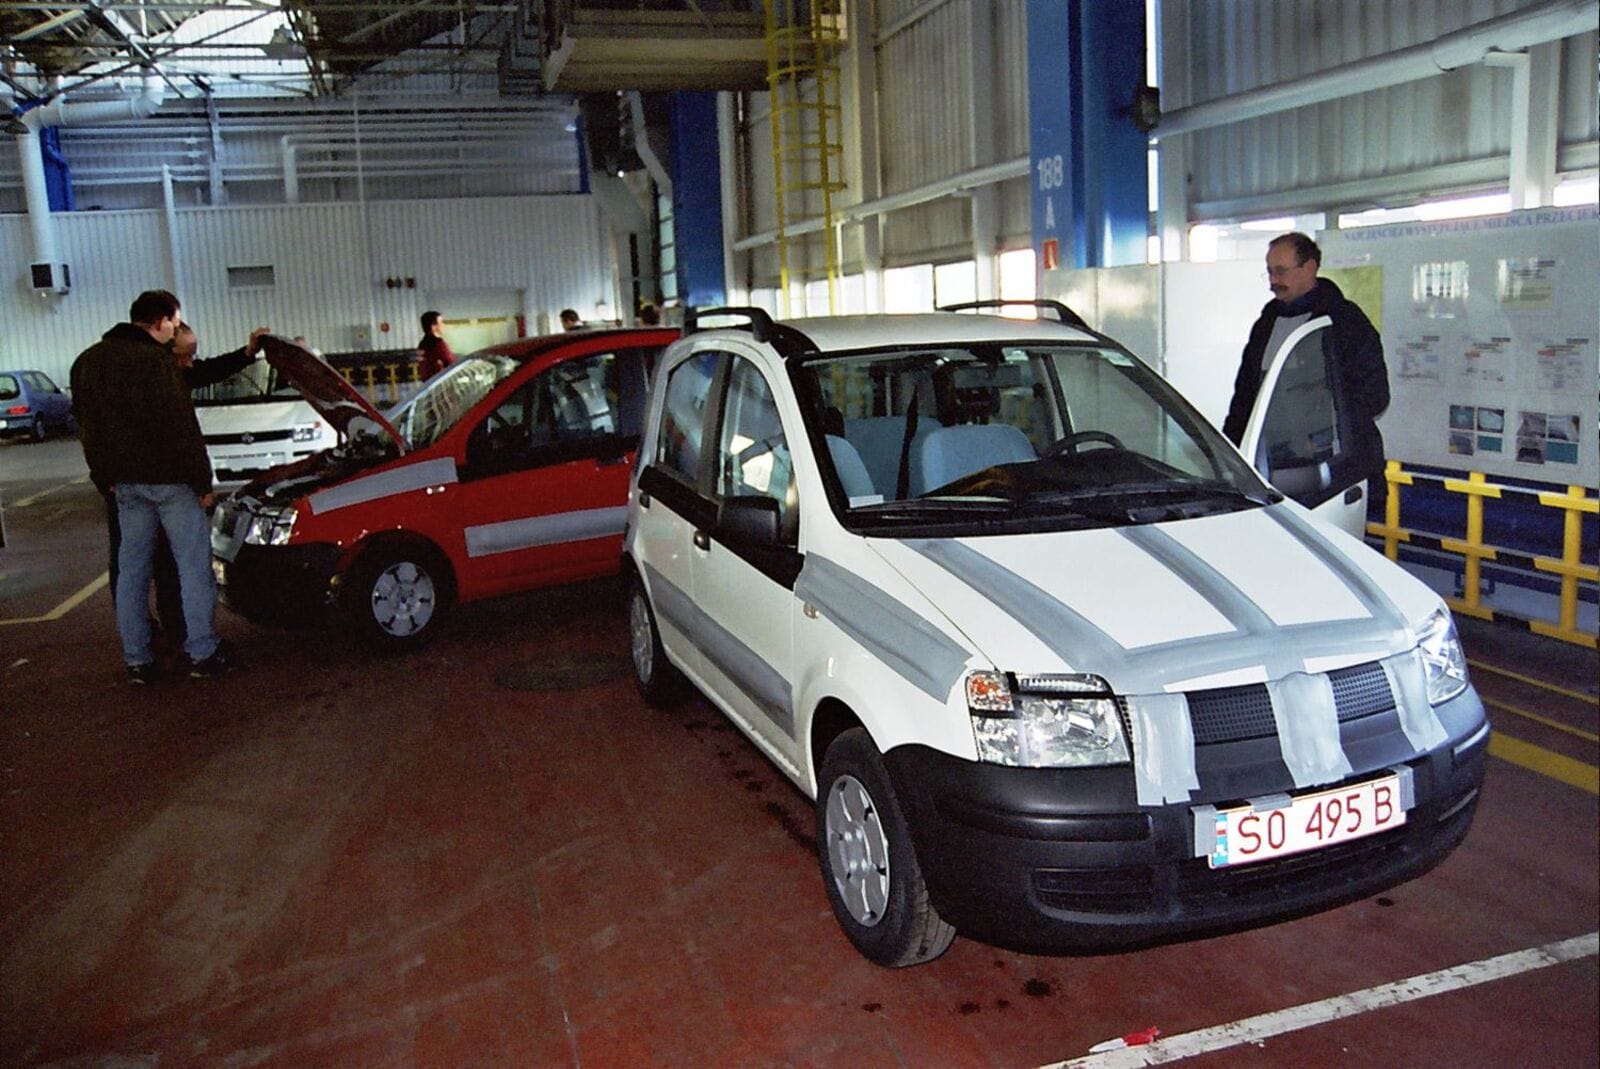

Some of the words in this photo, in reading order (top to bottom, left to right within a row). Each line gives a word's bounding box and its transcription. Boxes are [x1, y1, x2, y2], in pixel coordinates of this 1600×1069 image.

[1037, 154, 1063, 191] 188
[1045, 197, 1056, 230] A
[1305, 793, 1362, 841] 495
[1374, 786, 1393, 826] B
